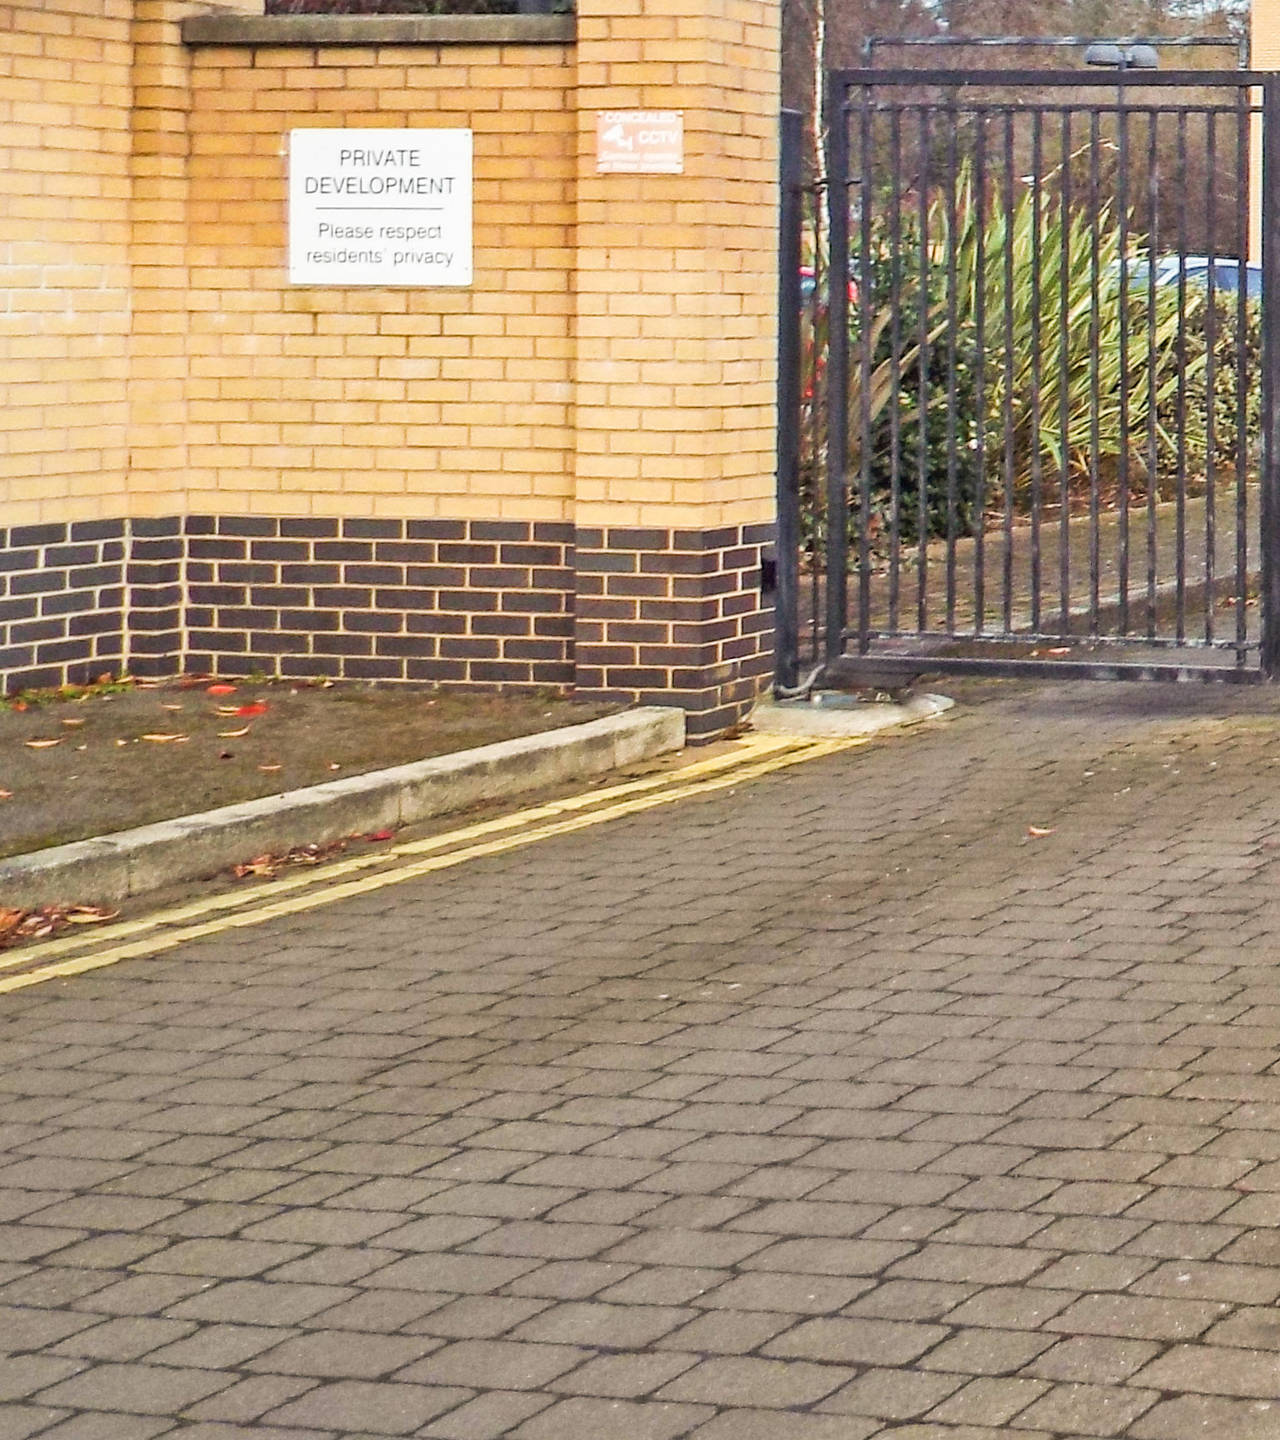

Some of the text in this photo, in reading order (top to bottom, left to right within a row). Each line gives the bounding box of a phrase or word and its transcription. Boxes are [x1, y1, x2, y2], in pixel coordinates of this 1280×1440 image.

[638, 130, 679, 145] CCTV
[340, 149, 421, 167] PRIVATE
[305, 176, 456, 195] DEVELOPMENT
[318, 222, 442, 242] Please respect
[393, 249, 454, 268] privacy
